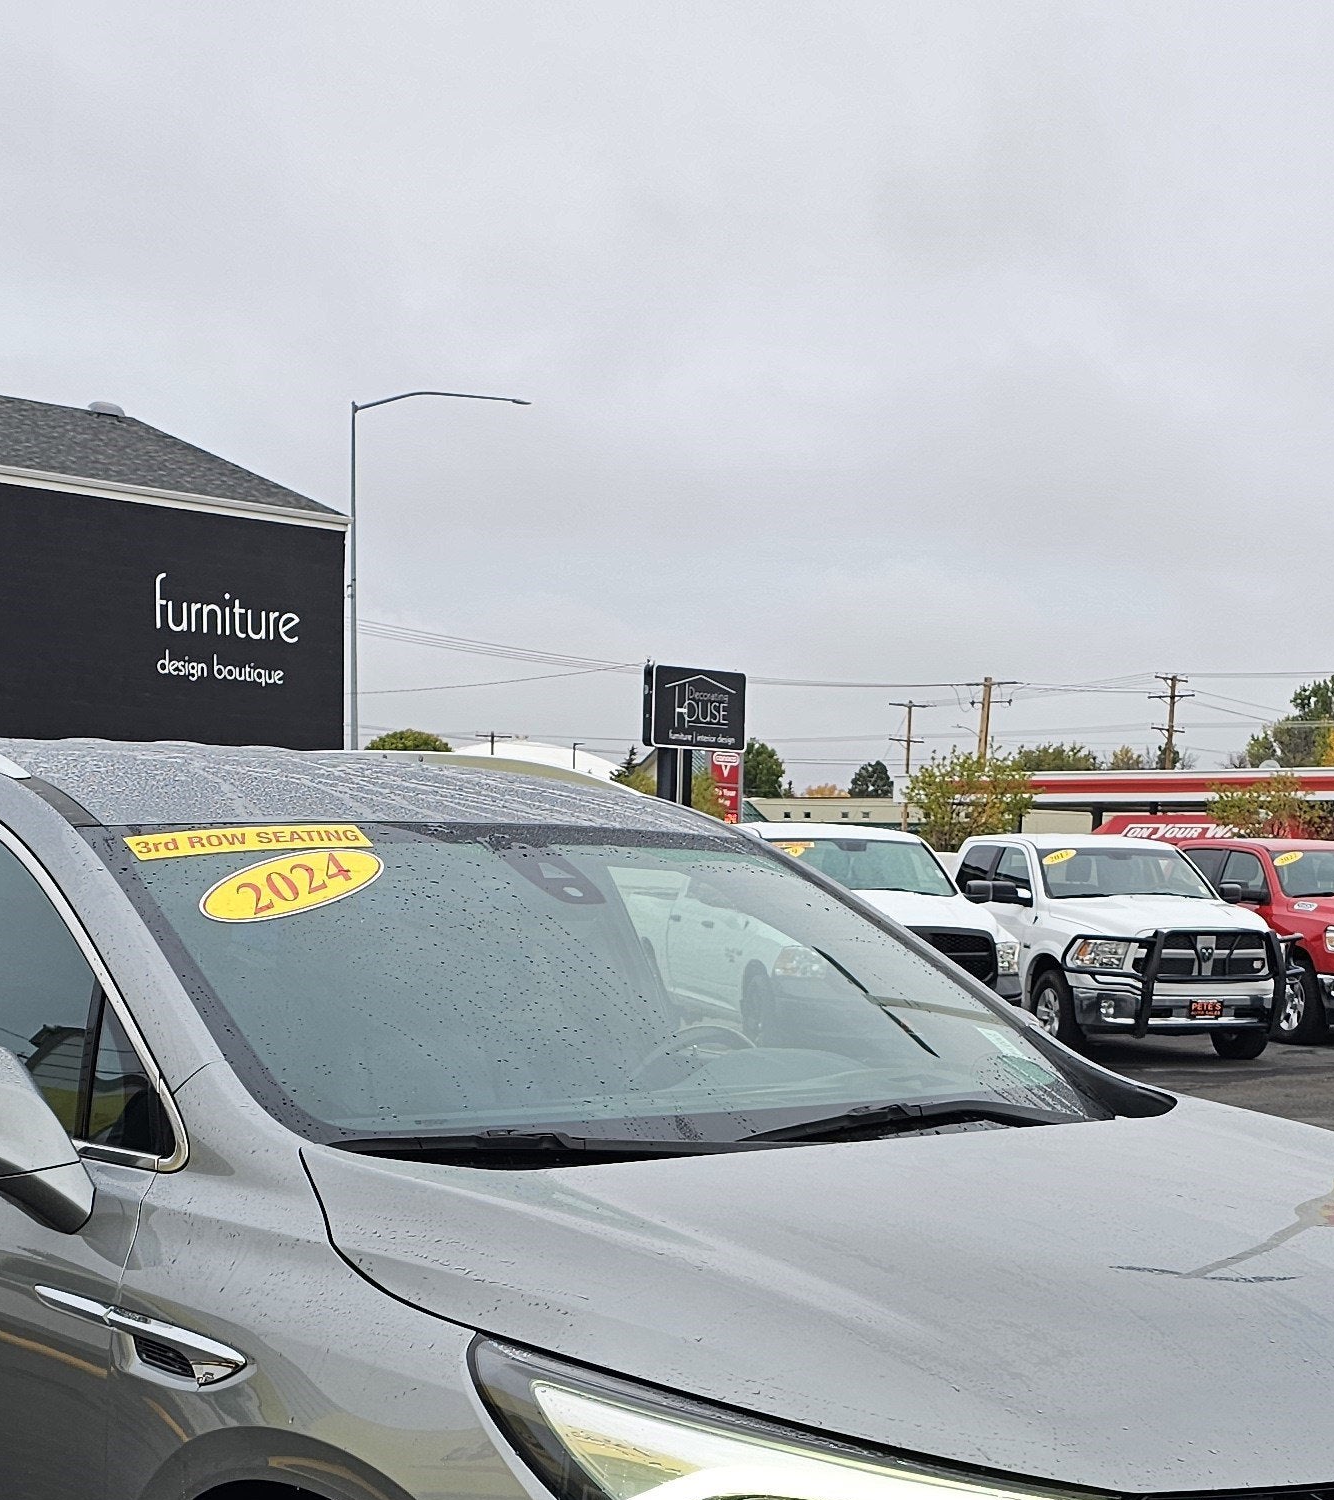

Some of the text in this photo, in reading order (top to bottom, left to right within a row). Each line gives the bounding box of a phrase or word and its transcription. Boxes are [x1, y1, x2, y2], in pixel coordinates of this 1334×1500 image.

[155, 572, 300, 643] furniture
[157, 649, 284, 687] design boutique
[689, 686, 729, 703] Decorating
[135, 829, 360, 854] 3rd ROW SEATING
[236, 853, 352, 915] 2024
